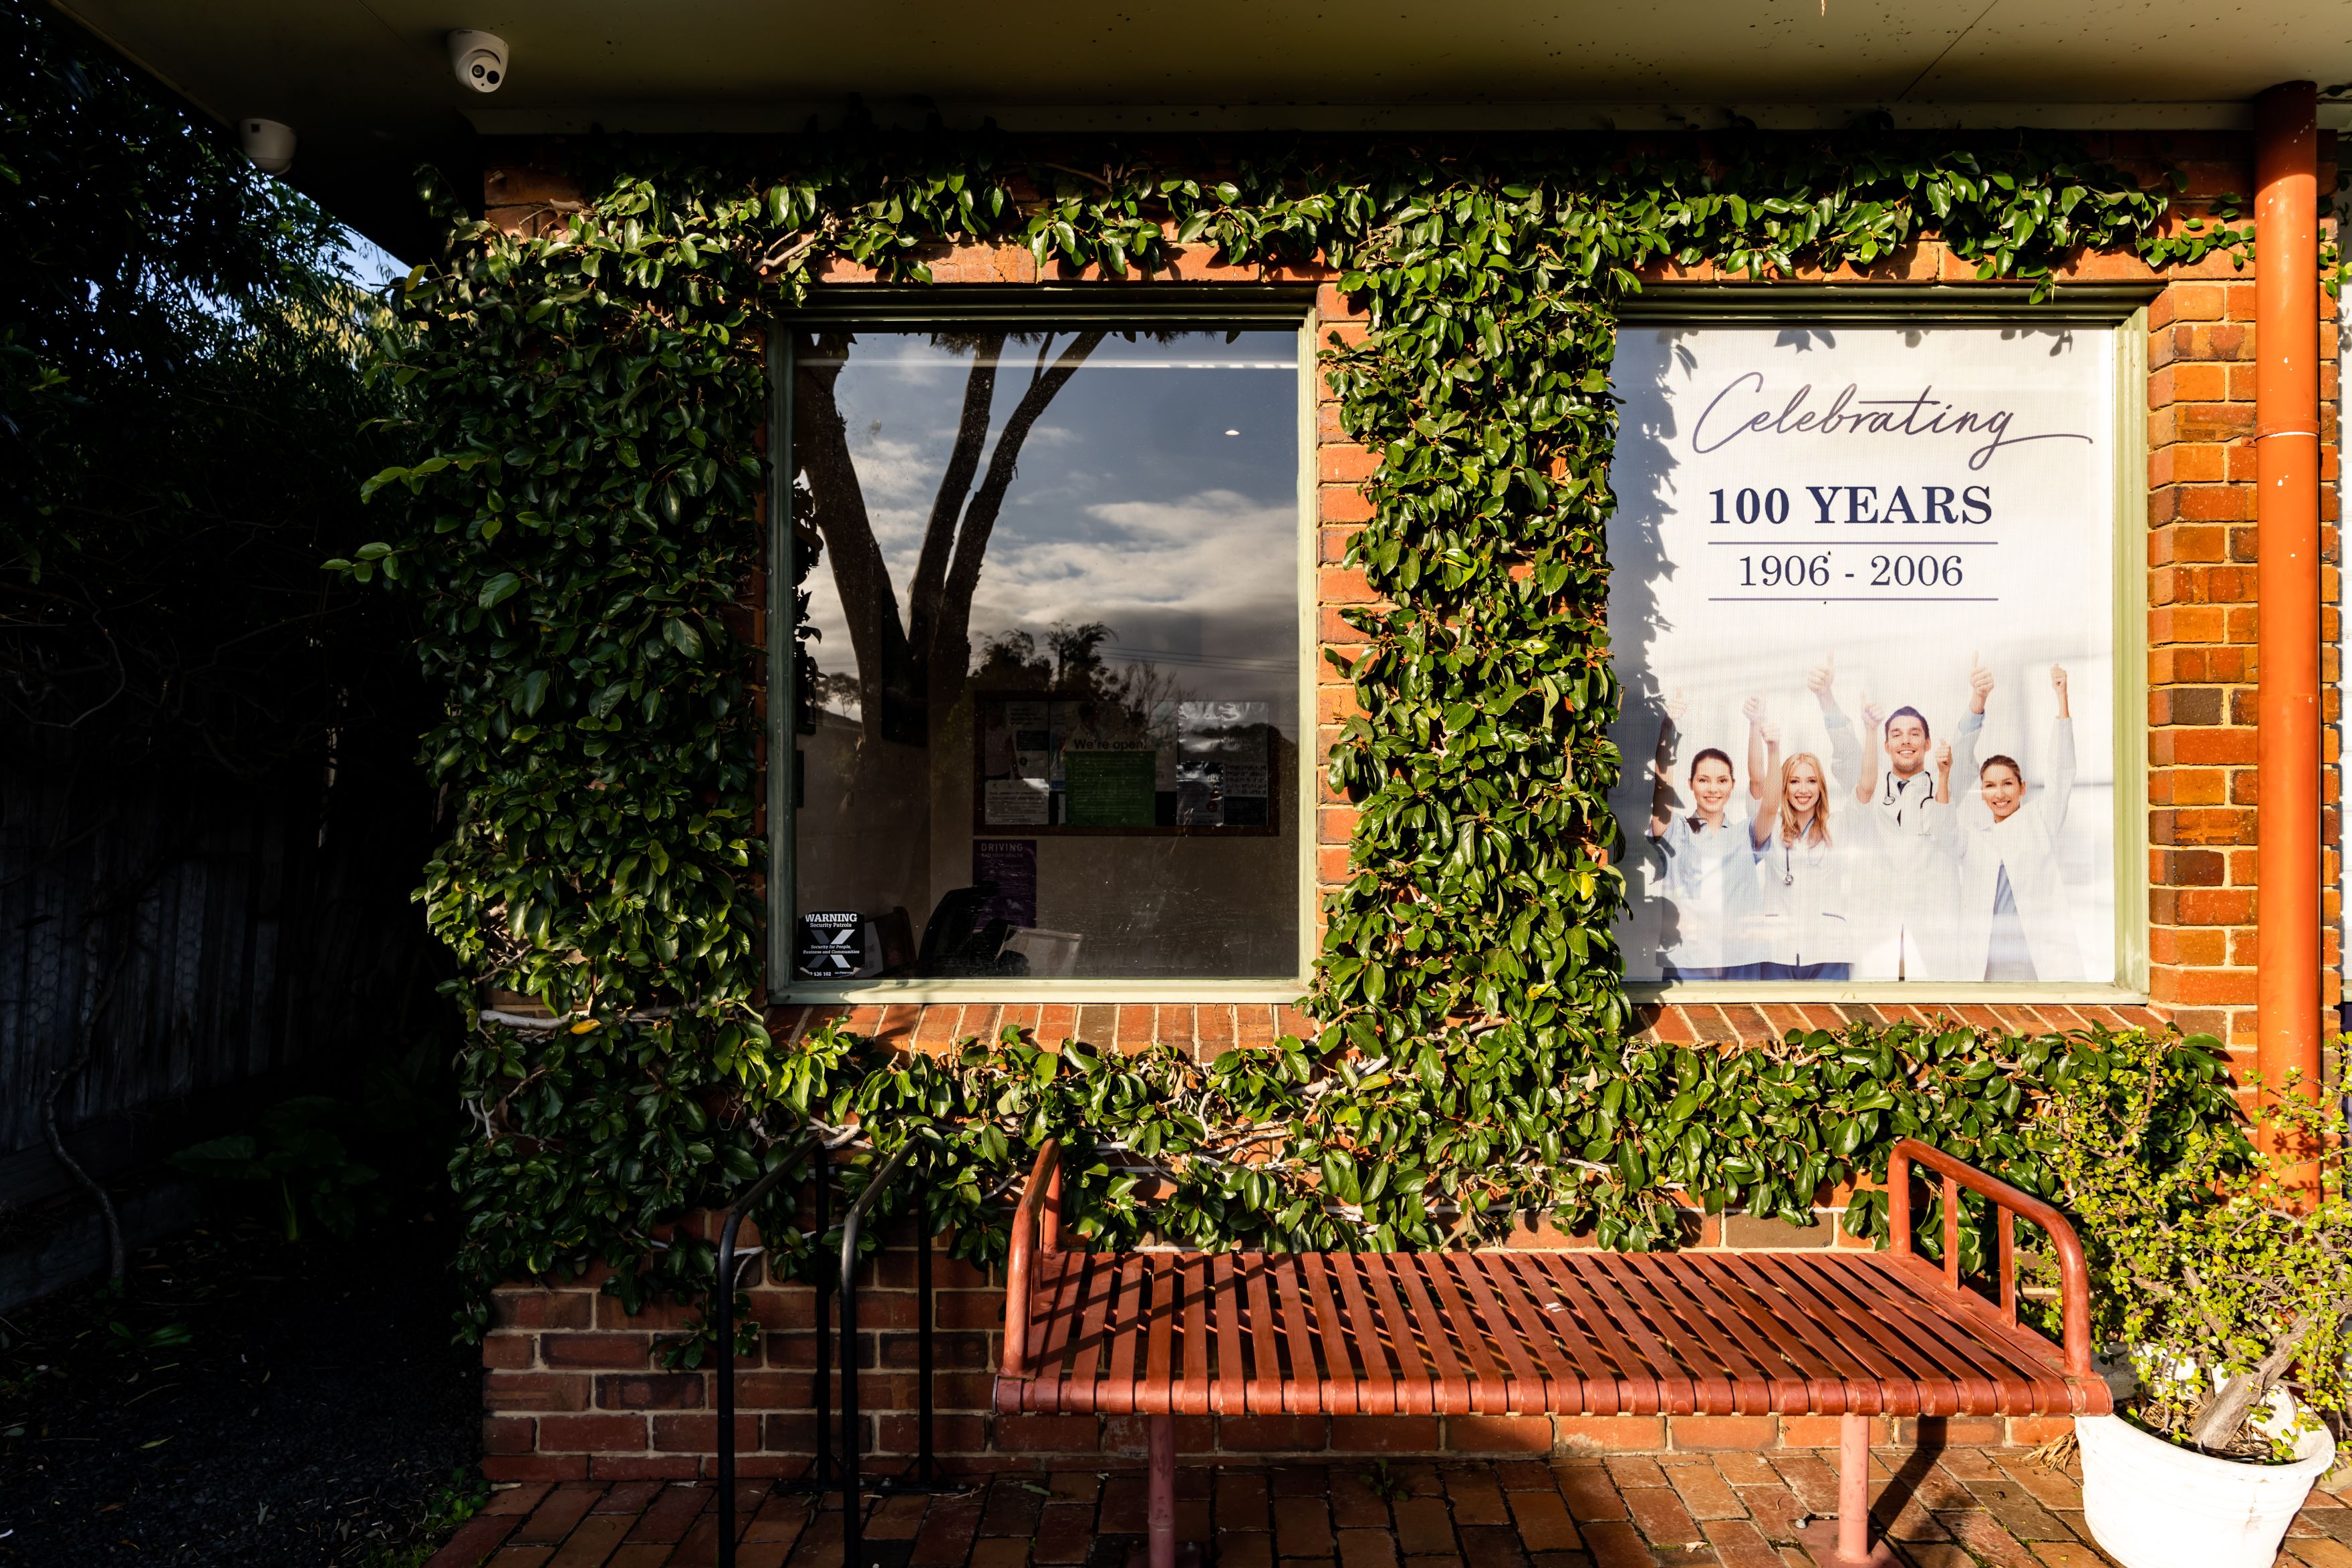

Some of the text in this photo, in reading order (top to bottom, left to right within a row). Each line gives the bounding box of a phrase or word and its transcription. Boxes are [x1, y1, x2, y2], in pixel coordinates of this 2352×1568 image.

[1692, 372, 2093, 471] Celebrating
[1708, 485, 1992, 525] 100 YEARS
[1739, 555, 1830, 586] 1906
[1870, 555, 1963, 586] 2006
[1074, 739, 1109, 749] We're
[981, 843, 1023, 852] DRIVING
[805, 913, 858, 922] WARNING
